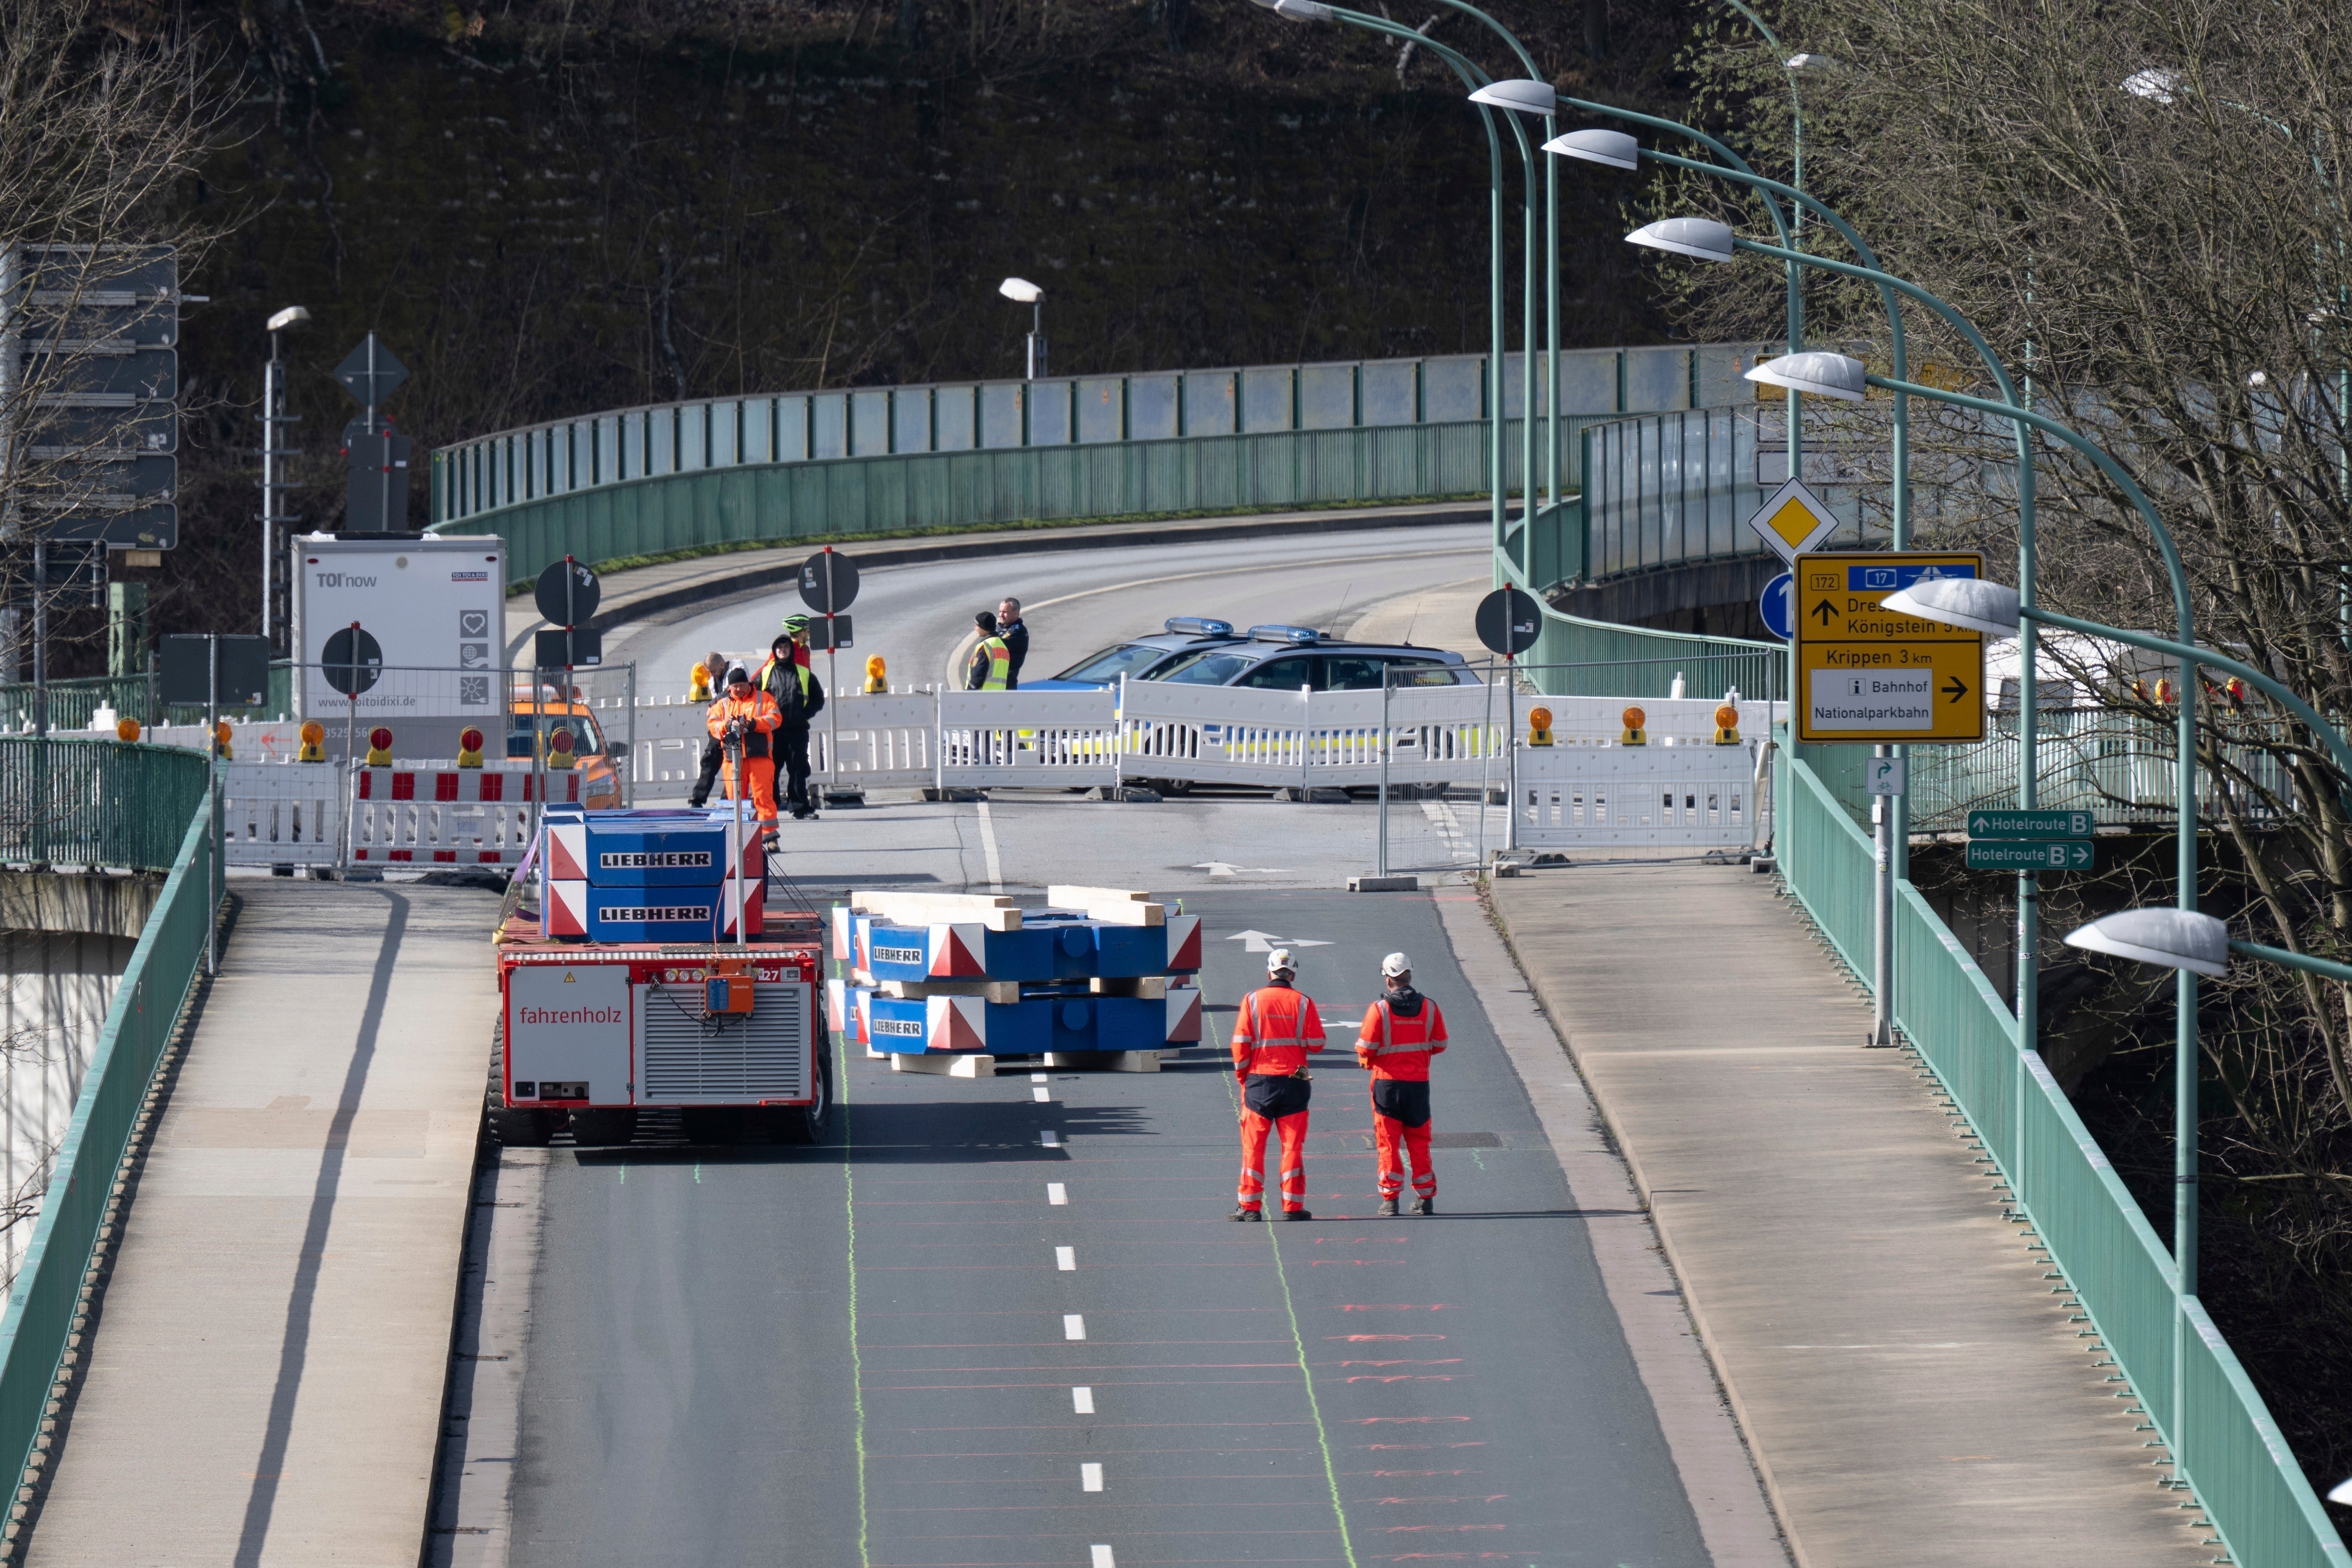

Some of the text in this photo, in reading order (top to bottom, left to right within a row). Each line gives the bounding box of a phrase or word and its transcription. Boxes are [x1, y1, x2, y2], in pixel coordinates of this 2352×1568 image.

[346, 577, 377, 587] now
[1816, 577, 1835, 588] 172
[1875, 572, 1887, 584] 17
[1848, 599, 1895, 612] Dres
[1848, 619, 1935, 637] Königstein
[1944, 623, 1953, 633] 5
[1827, 649, 1932, 667] Krippen 3 km
[1872, 681, 1928, 693] Bahnhof
[318, 696, 416, 707] www.oitoidixi.de
[1815, 707, 1929, 721] Nationalparkbahn
[1992, 815, 2087, 833] Hotelroute B
[602, 853, 709, 866] LIEBHERR
[1971, 847, 2065, 864] Hotelroute B
[601, 908, 708, 920] LIEBHERR
[874, 948, 921, 962] LIEBHERR
[519, 1006, 621, 1024] fahrenholz
[874, 1020, 920, 1035] LIEBHERR
